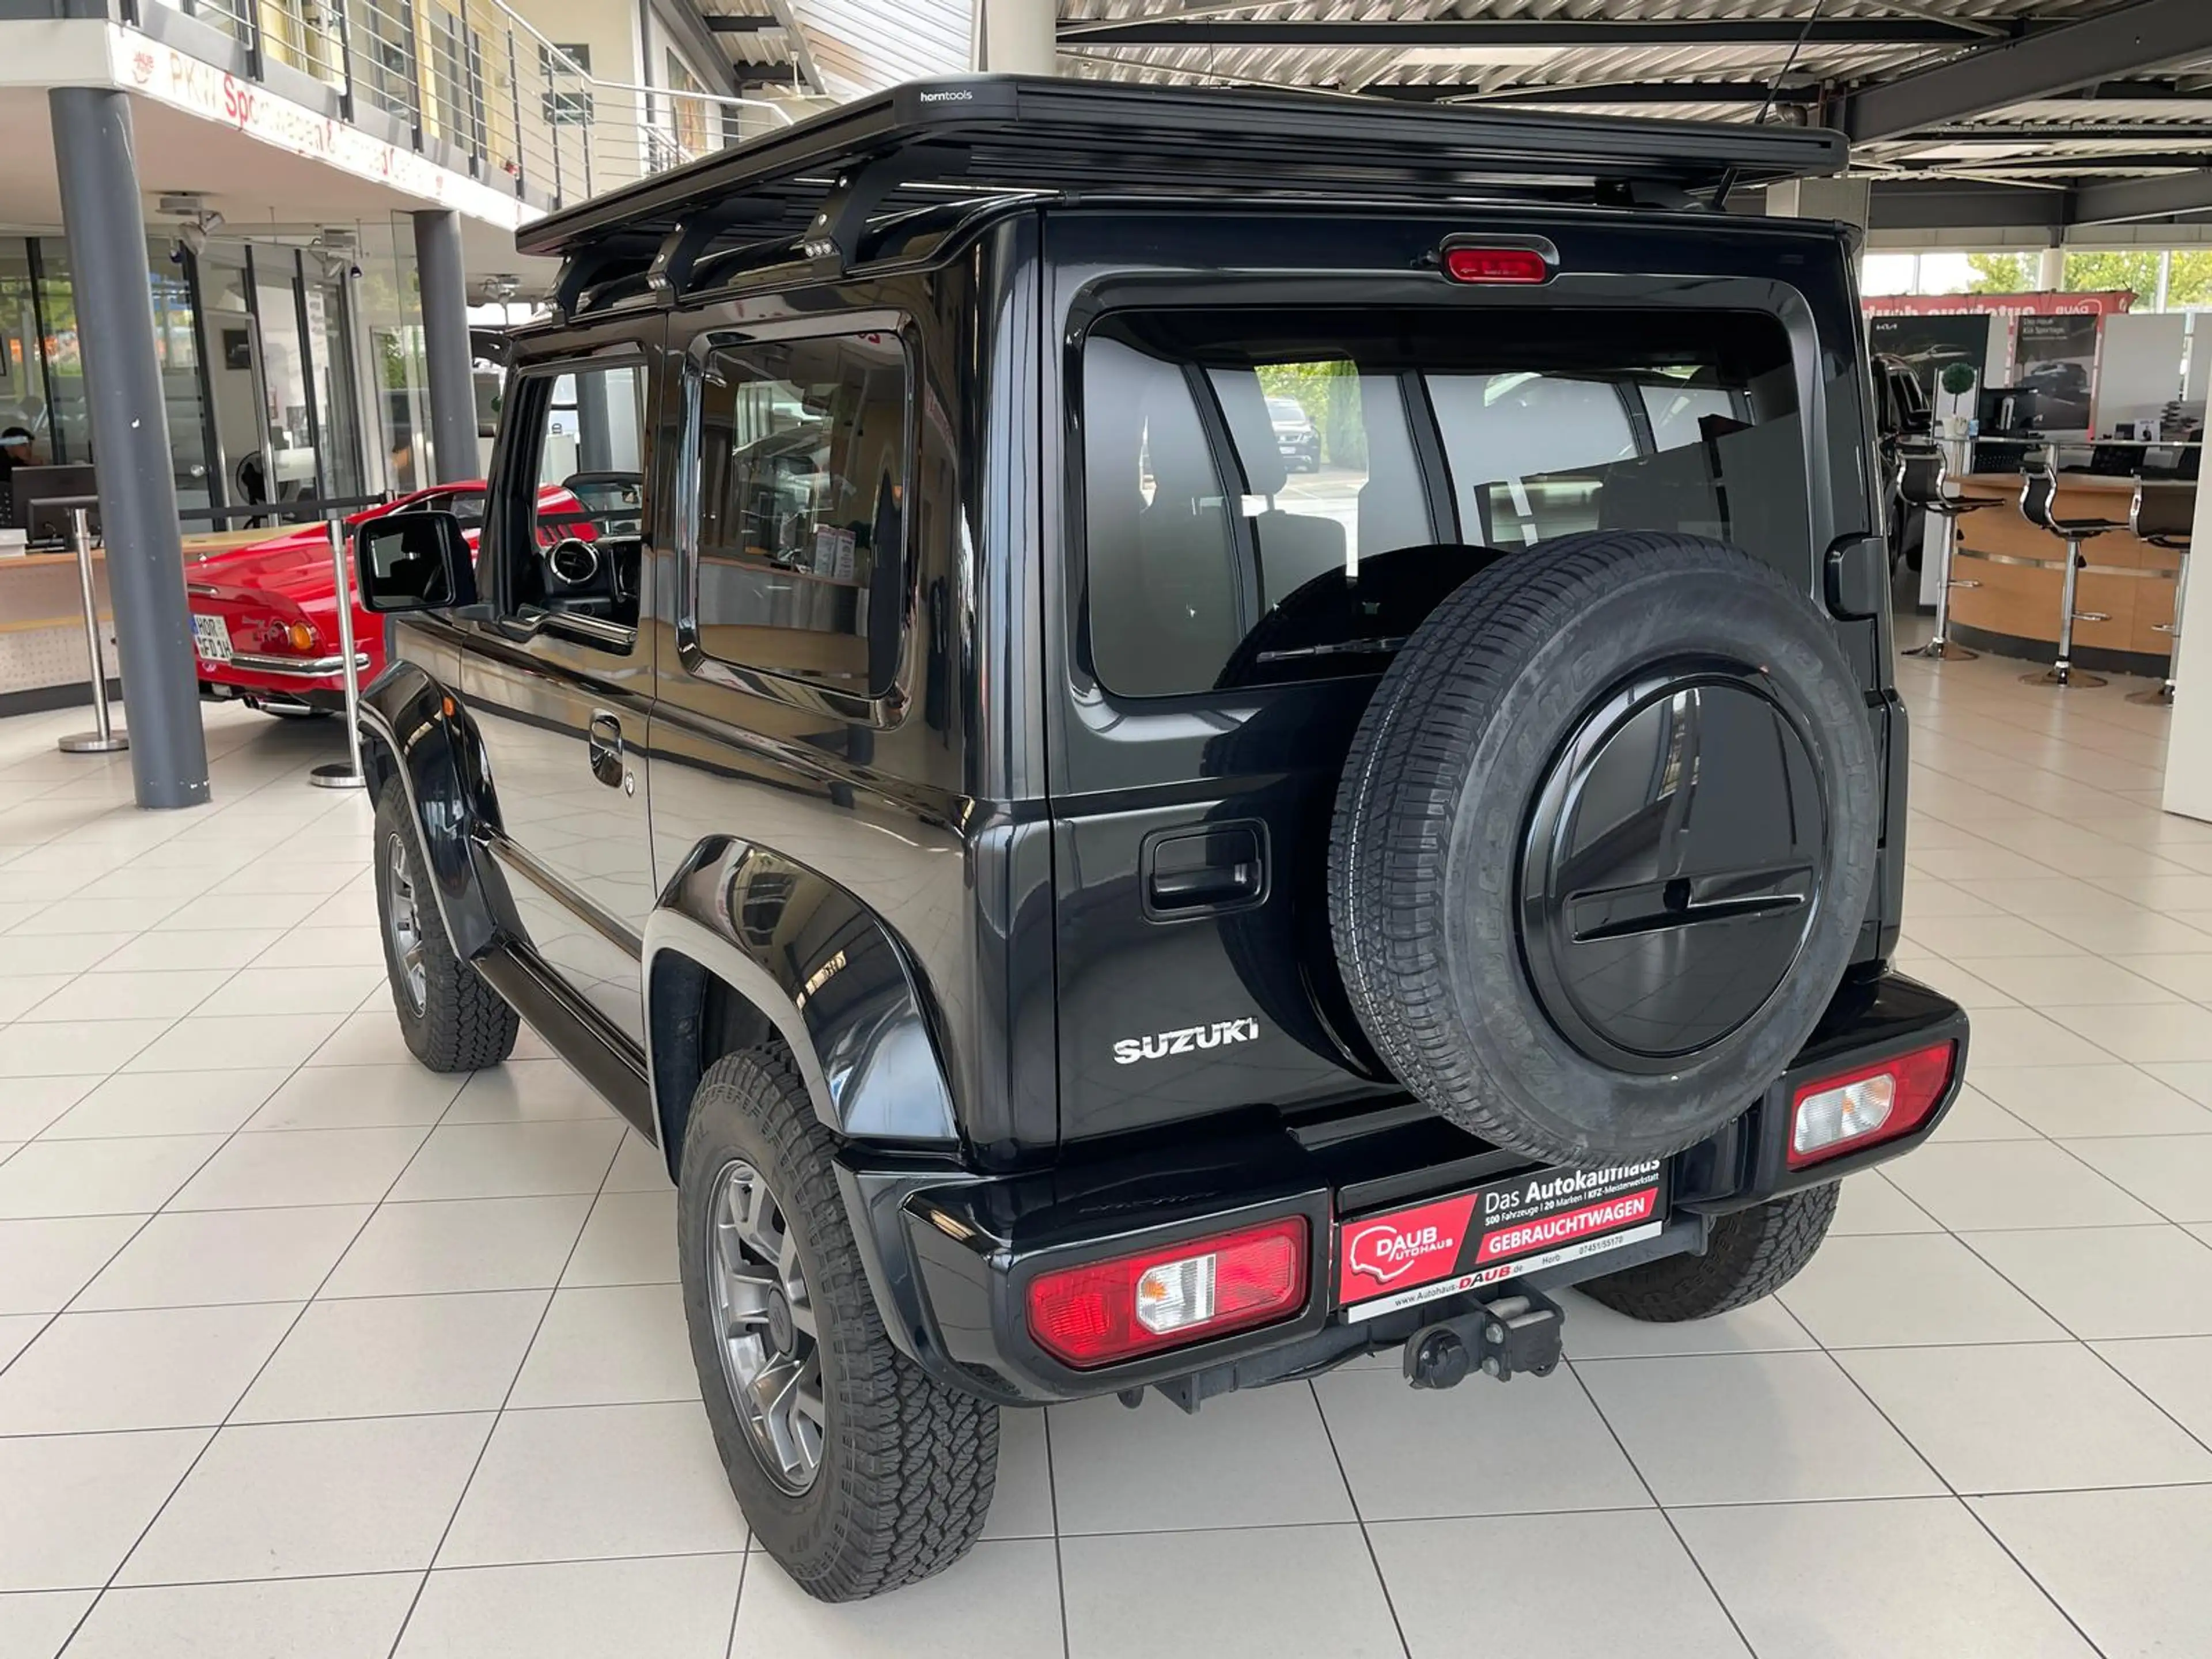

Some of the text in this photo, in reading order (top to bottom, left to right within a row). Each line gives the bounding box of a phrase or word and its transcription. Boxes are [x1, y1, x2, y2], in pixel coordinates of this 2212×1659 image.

[921, 90, 973, 102] horntools
[1113, 1017, 1259, 1065] SUZUKI
[1484, 1214, 1501, 1226] 500
[1501, 1206, 1539, 1221] Fahrzeuge
[1544, 1200, 1555, 1211] 20
[1556, 1194, 1582, 1207] Marken
[1588, 1172, 1660, 1200] KFZ-Meisterwerkstatt
[1485, 1158, 1660, 1214] Das Autokaufhaus
[1376, 1226, 1438, 1262] DAUB
[1488, 1196, 1645, 1254] GEBRAUCHTWAGEN
[1542, 1253, 1560, 1266] Horb
